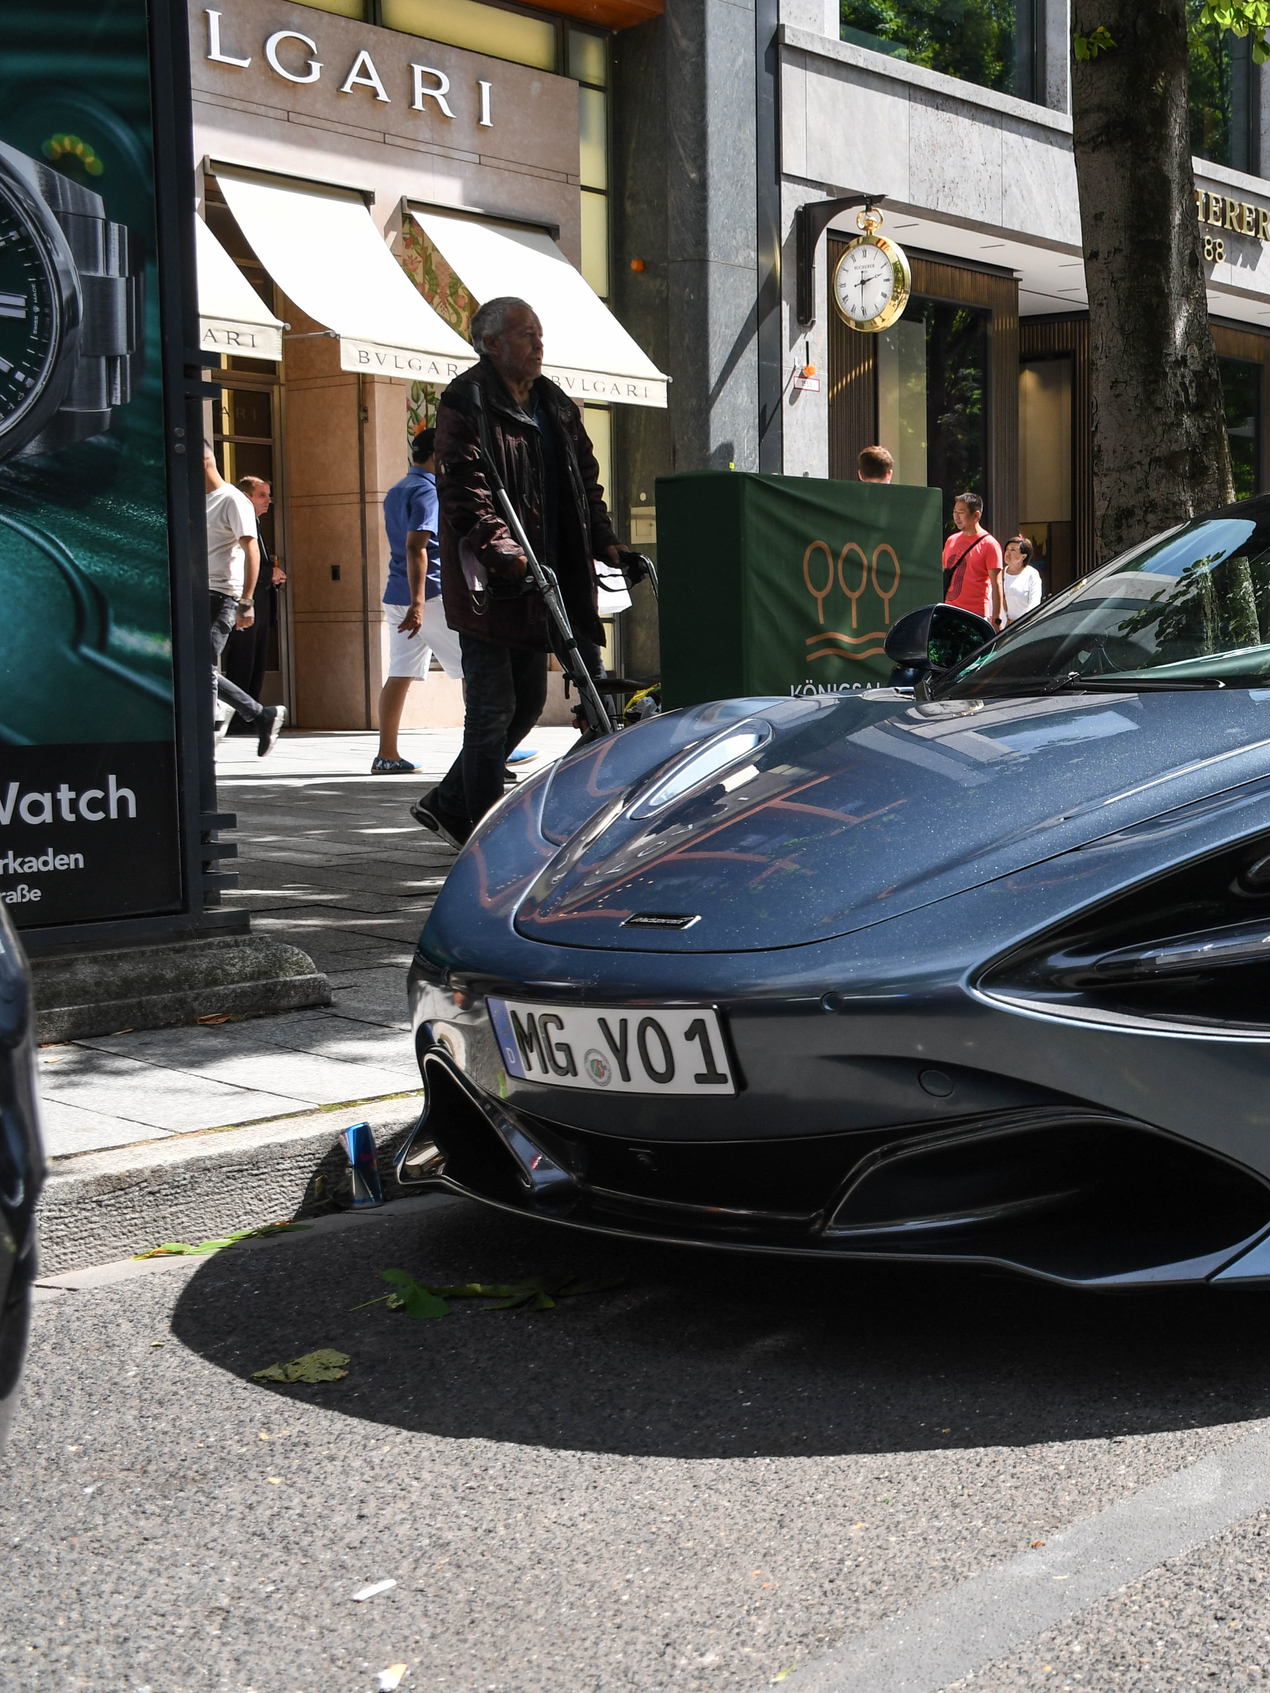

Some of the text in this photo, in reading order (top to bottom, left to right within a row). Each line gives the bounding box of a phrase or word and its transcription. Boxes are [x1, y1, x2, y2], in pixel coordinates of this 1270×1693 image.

[205, 9, 493, 127] LGARI
[1203, 235, 1224, 263] 88
[358, 350, 472, 377] BVLGAR
[551, 375, 648, 398] BVLGARI
[506, 1047, 515, 1064] D
[510, 1010, 577, 1077] MG
